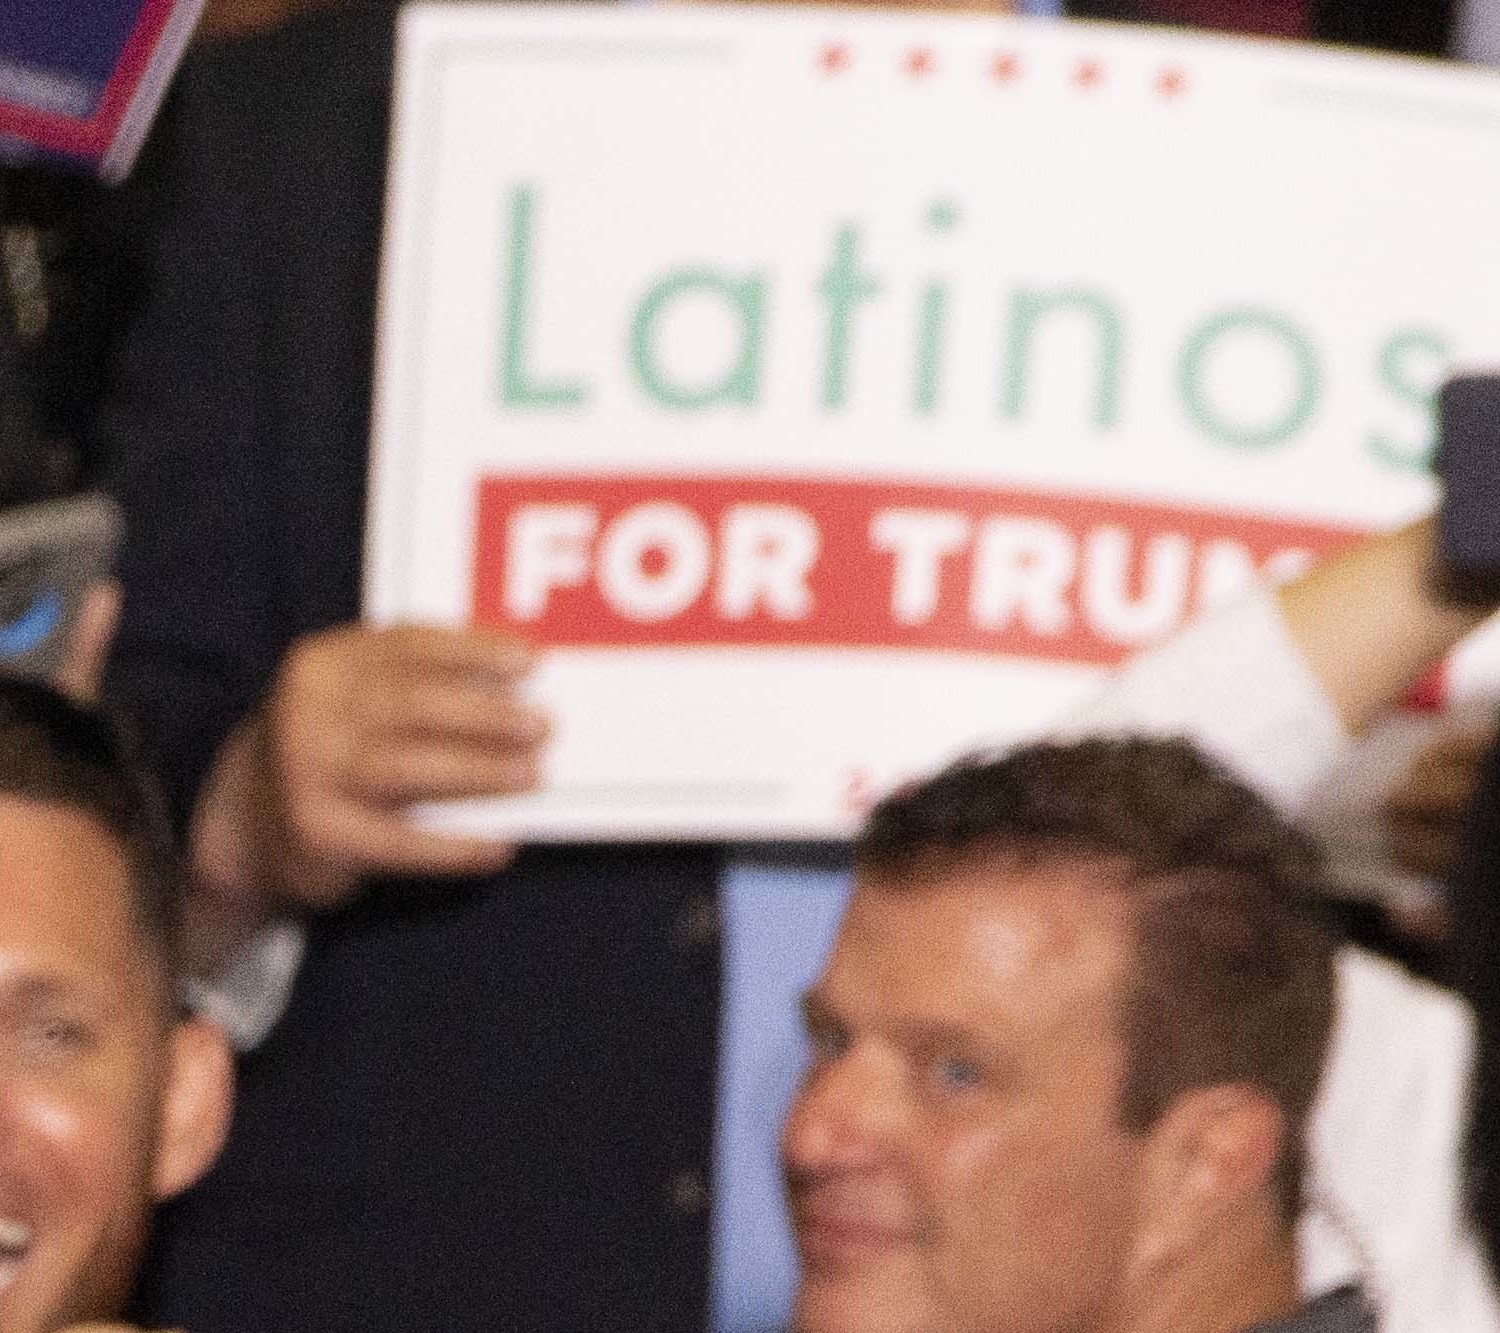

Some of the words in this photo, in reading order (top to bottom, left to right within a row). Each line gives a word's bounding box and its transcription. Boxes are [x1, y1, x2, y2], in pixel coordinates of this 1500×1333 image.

[502, 184, 1448, 476] Latinos
[506, 500, 823, 622] FOR
[867, 506, 1317, 643] TRU
